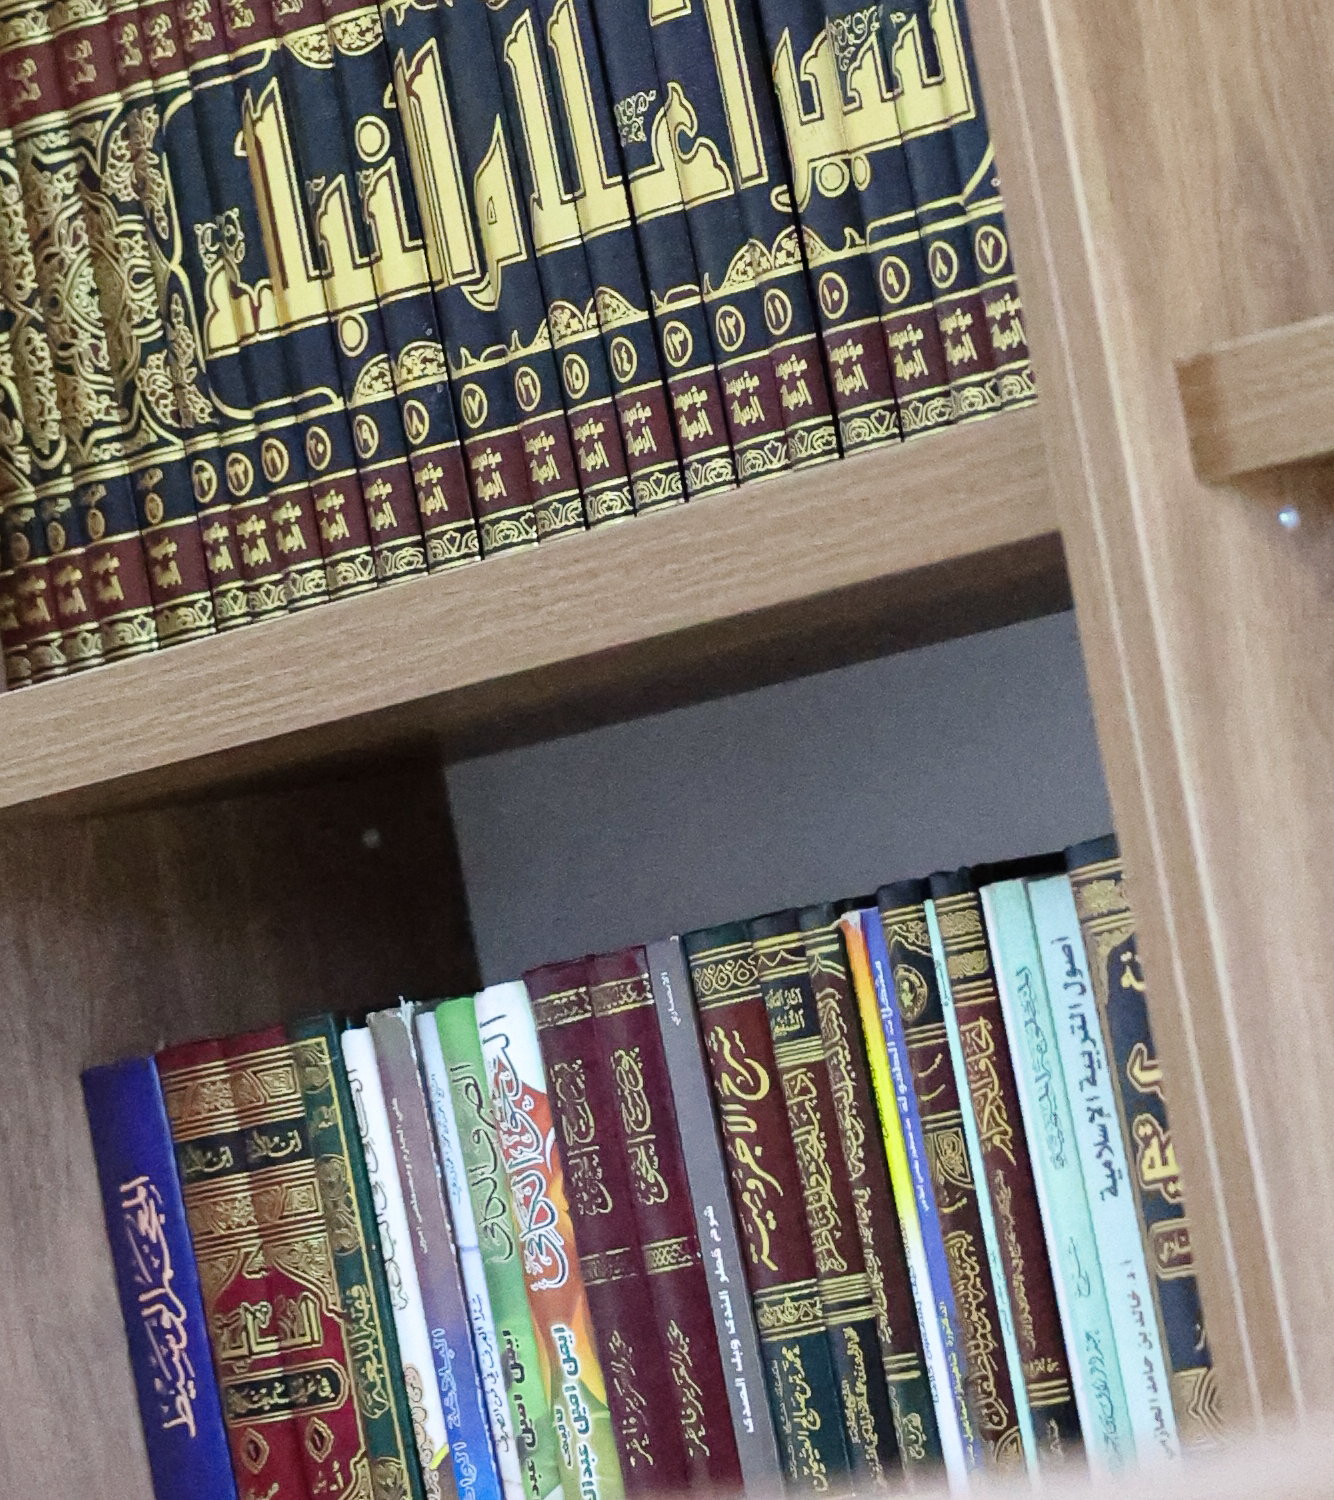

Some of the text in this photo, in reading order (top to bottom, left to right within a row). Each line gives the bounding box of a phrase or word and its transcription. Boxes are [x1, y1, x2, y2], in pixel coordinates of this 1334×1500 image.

[608, 1045, 669, 1207] توضيح النحو
[706, 1016, 771, 1107] شرح
[1051, 934, 1124, 1200] أصول التربية الإسلامية
[120, 1174, 204, 1442] المعجم الوسيط
